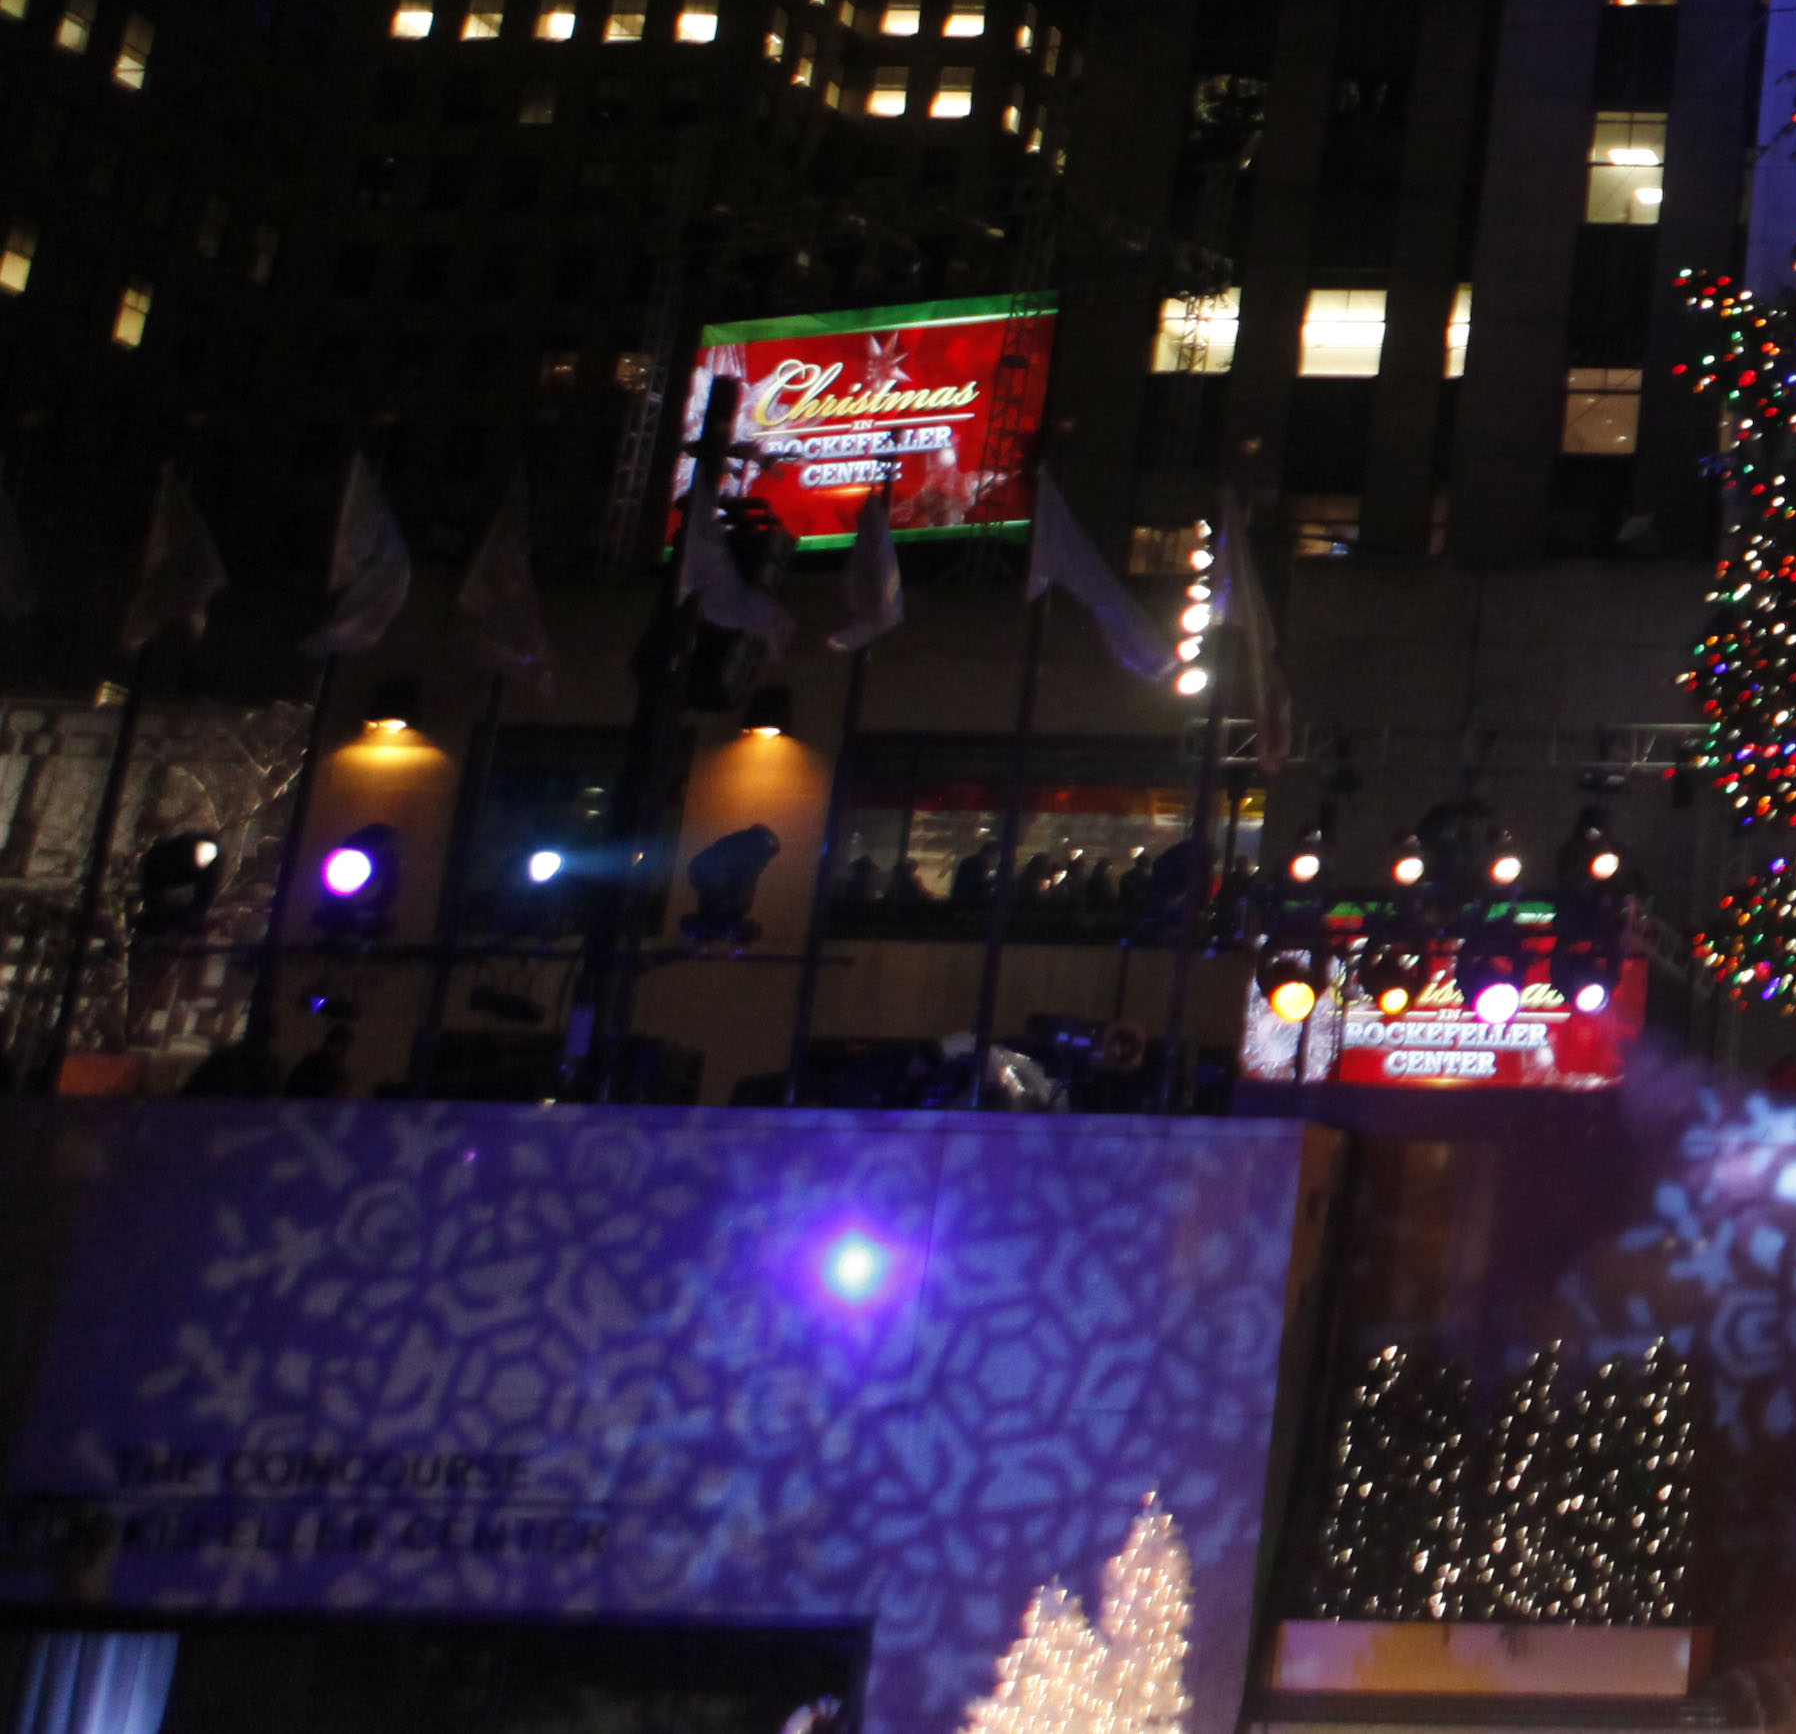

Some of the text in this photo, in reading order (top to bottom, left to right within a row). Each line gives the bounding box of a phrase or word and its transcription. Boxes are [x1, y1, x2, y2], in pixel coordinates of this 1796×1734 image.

[756, 358, 980, 426] Christmas
[852, 419, 874, 431] IN
[1342, 1022, 1548, 1050] ROCKEFELLER
[1384, 1050, 1497, 1078] CENTER
